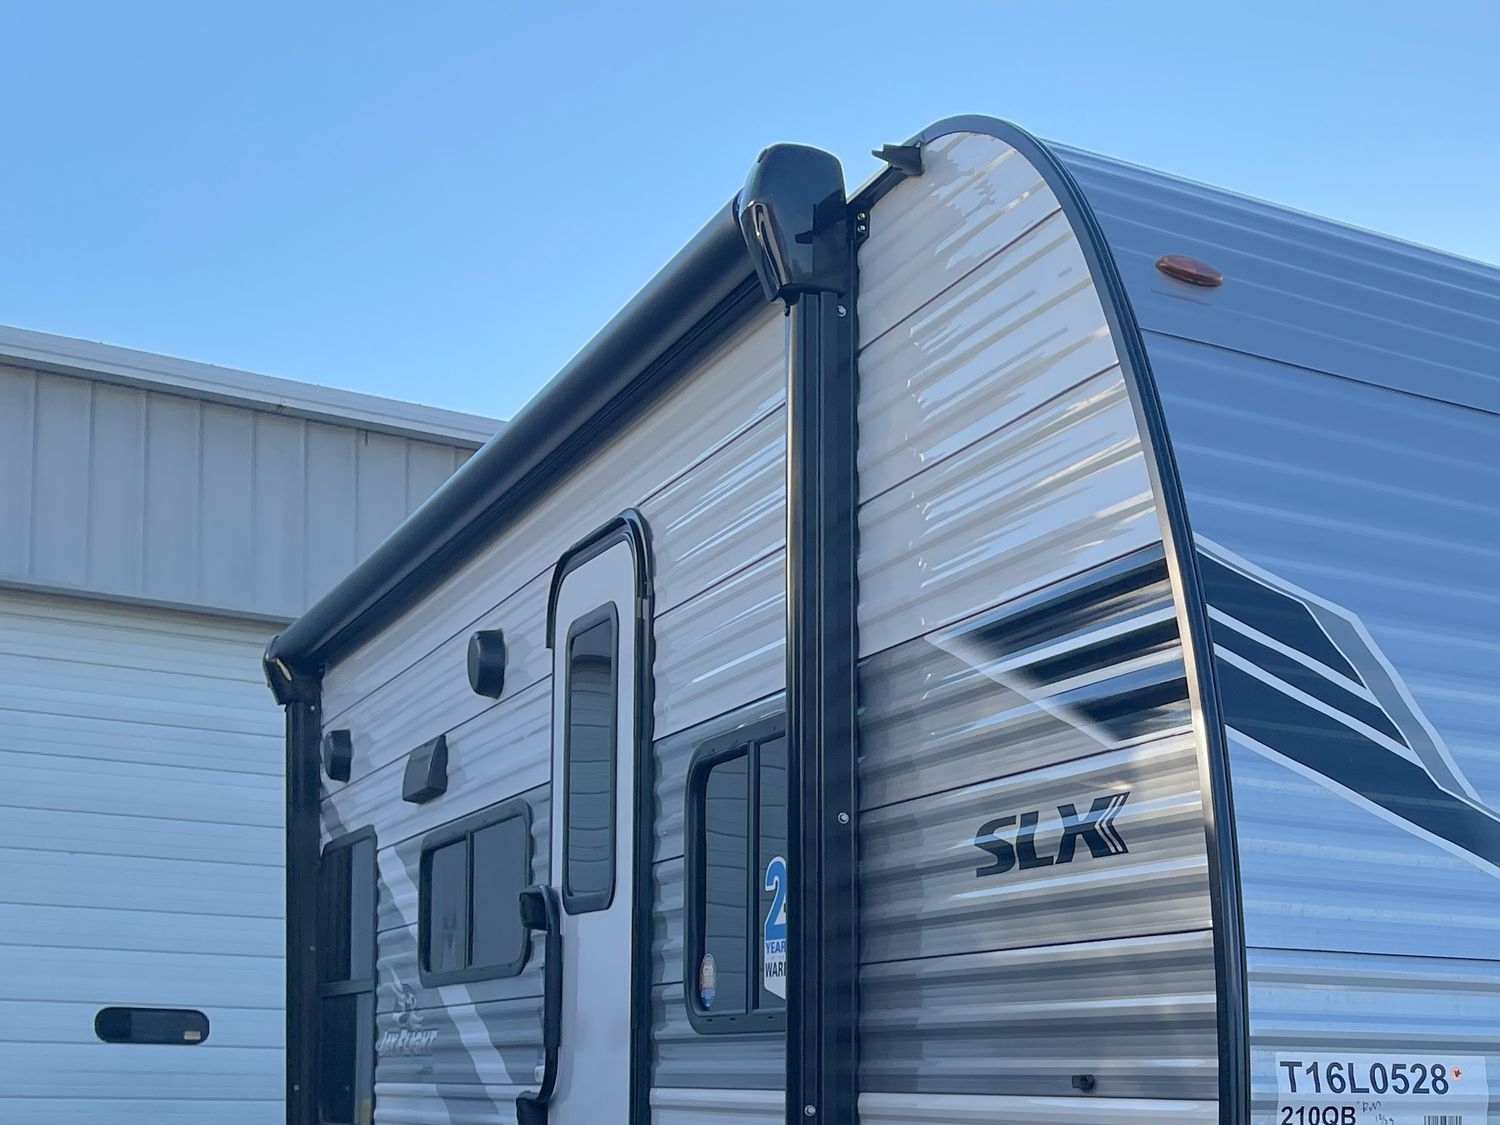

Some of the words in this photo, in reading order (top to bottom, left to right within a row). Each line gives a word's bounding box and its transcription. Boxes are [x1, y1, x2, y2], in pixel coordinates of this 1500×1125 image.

[974, 791, 1131, 878] SLX
[765, 857, 787, 941] 2
[1279, 1061, 1449, 1095] T16L0528
